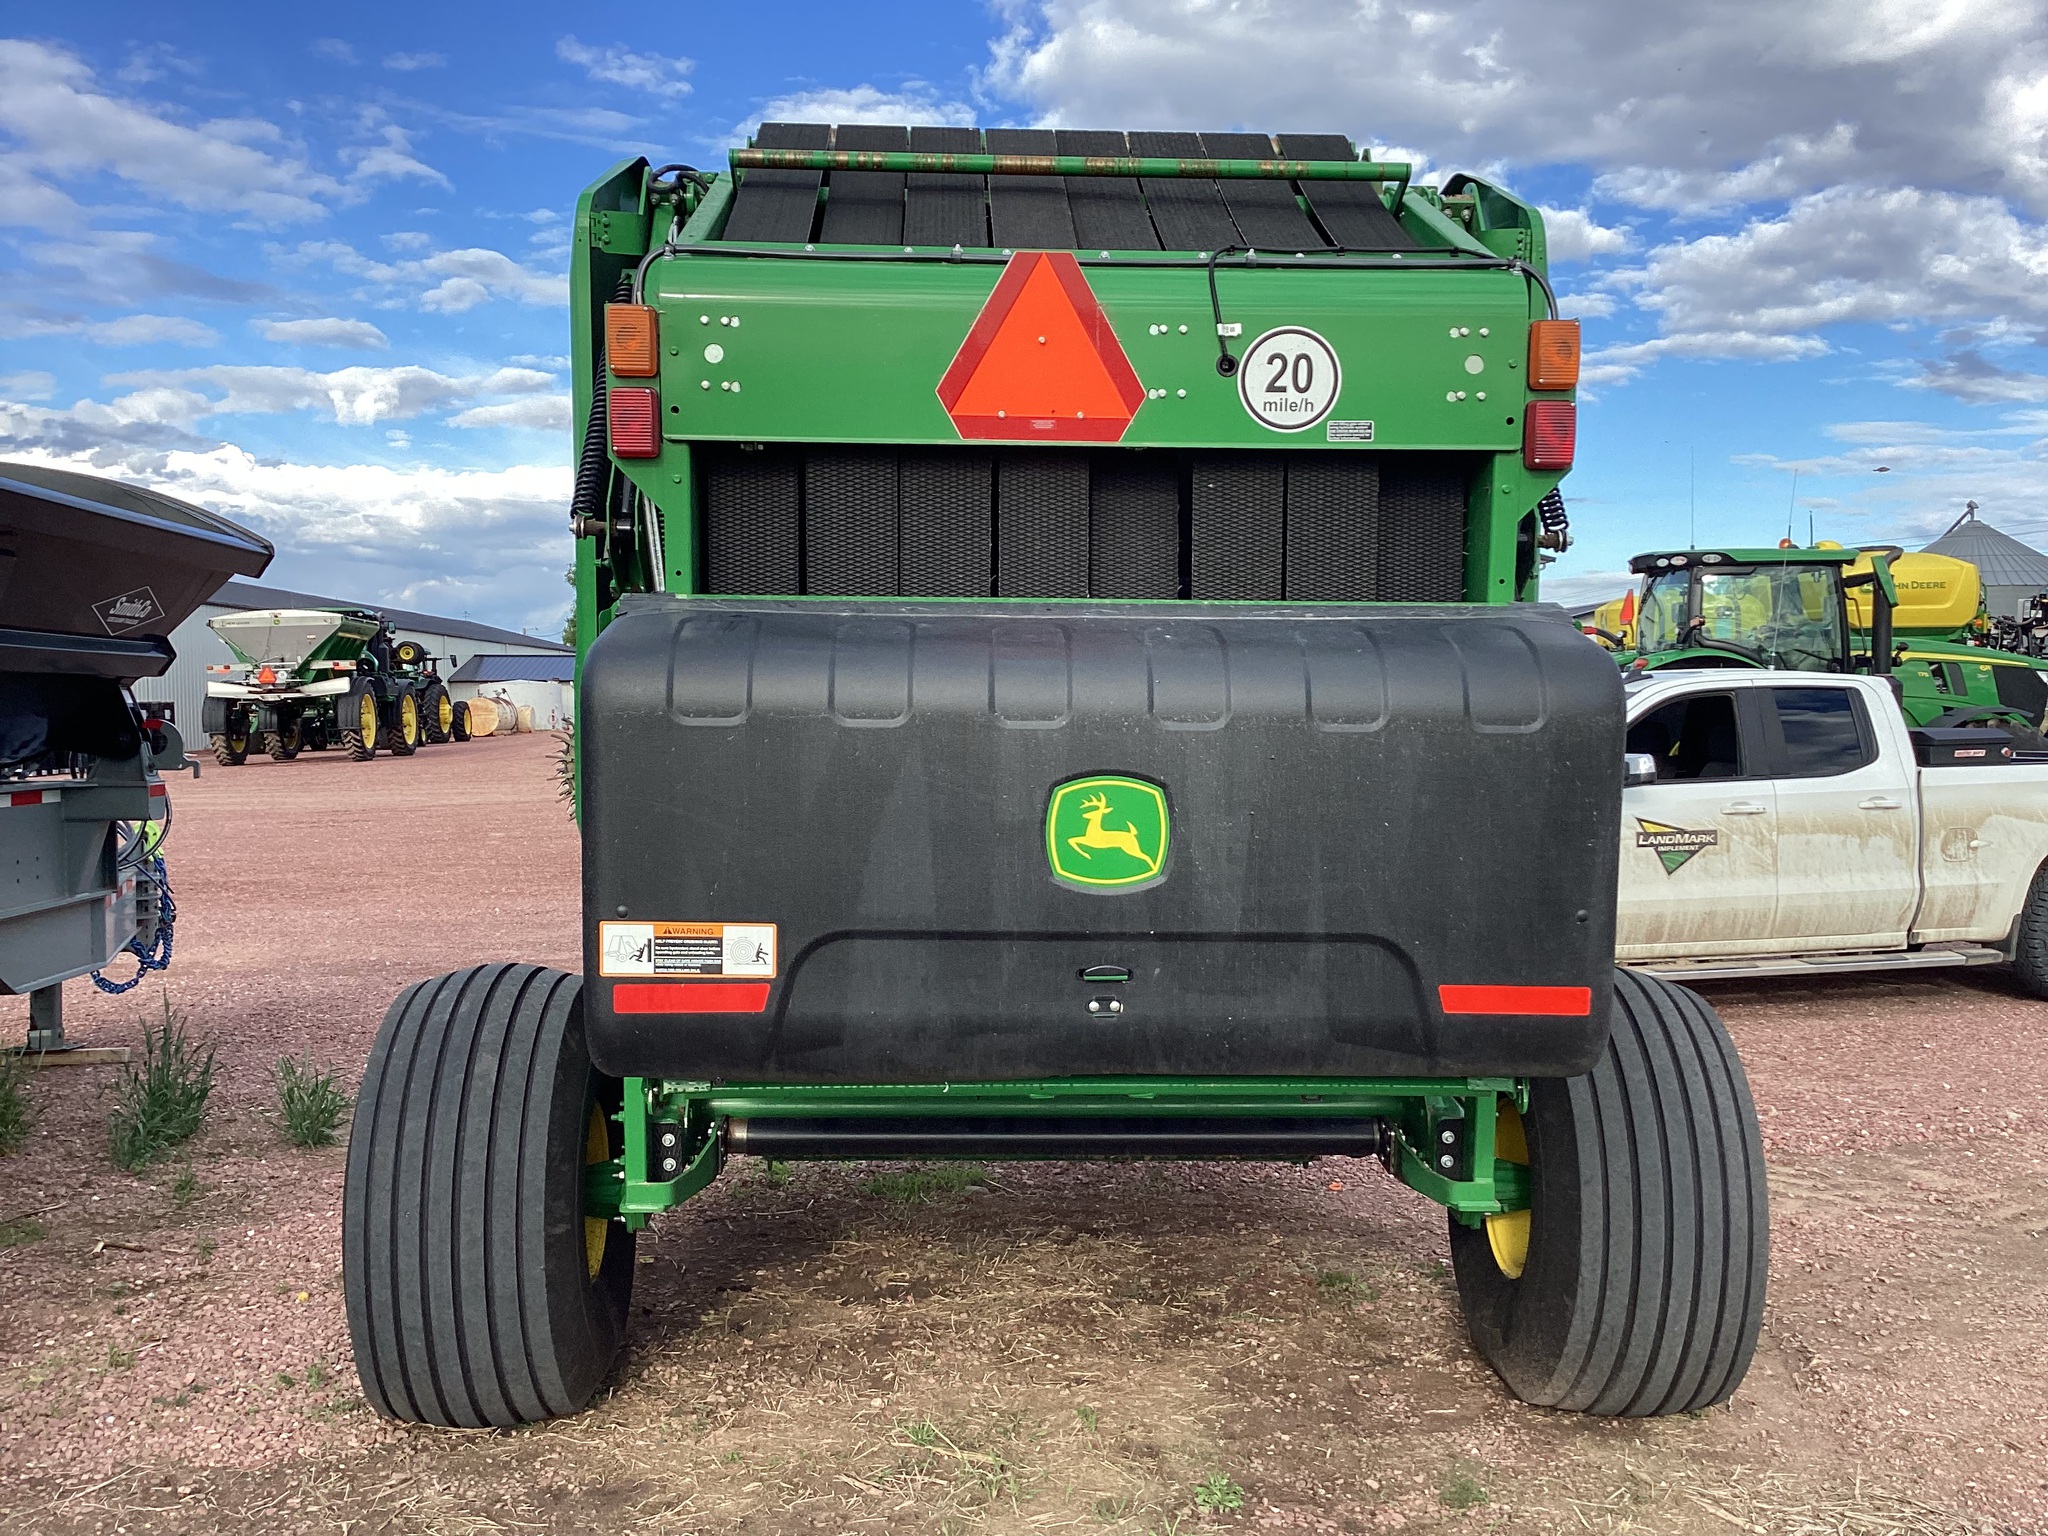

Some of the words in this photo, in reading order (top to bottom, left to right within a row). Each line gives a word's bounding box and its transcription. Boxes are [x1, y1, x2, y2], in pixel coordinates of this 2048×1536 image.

[1265, 352, 1313, 394] 20
[1263, 398, 1314, 412] mile/h
[1911, 580, 1946, 589] DEERE
[672, 927, 714, 935] WARNING
